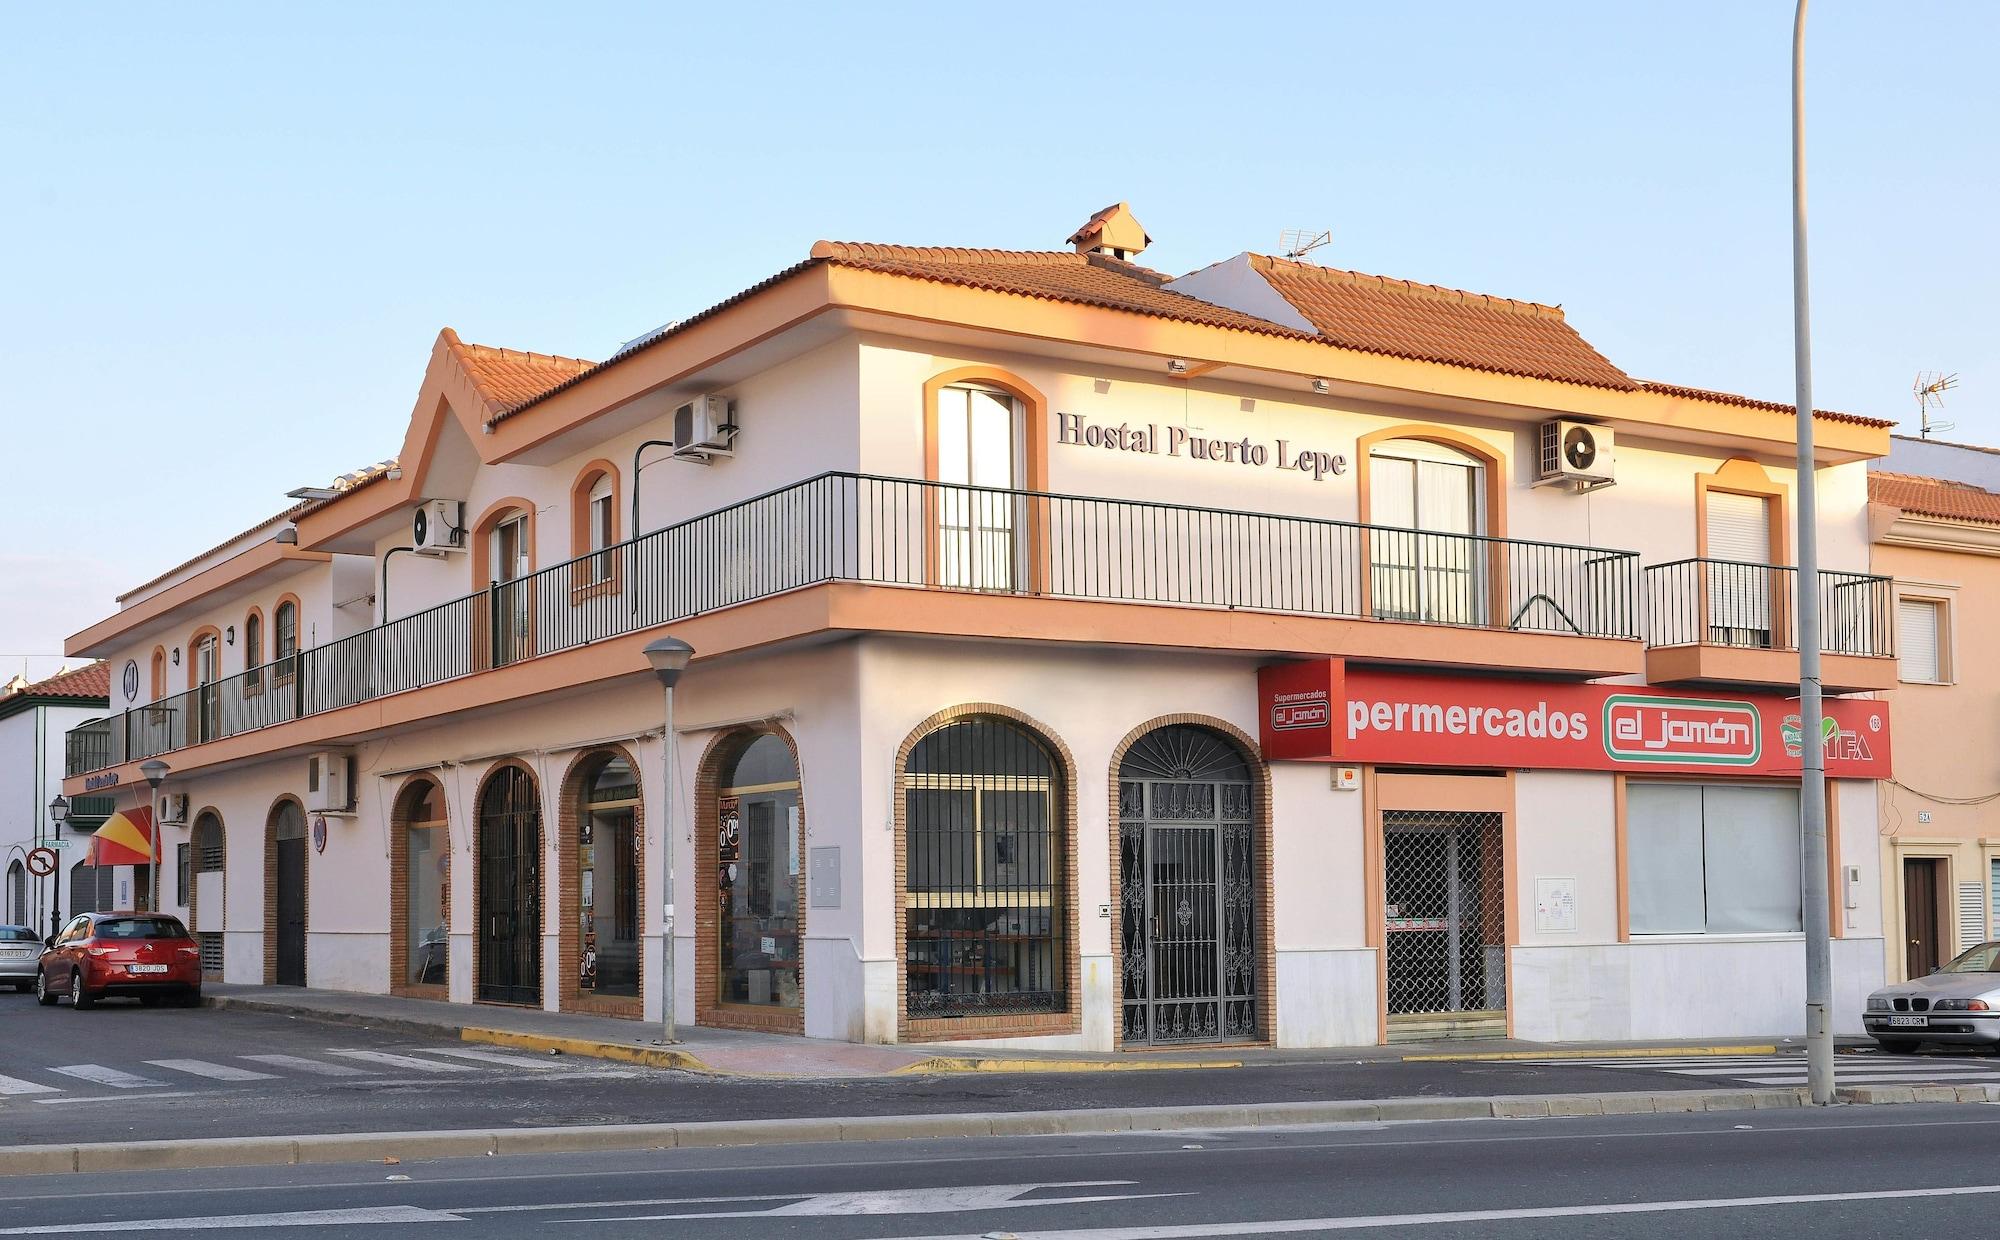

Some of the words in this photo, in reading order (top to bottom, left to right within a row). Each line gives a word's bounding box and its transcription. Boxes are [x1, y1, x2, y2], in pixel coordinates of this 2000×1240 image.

[1056, 412, 1159, 454] Hostal
[1167, 425, 1269, 466] Puerto
[1275, 439, 1347, 482] Lepe
[1274, 689, 1327, 703] Supermercados
[1347, 700, 1589, 740] permercados
[1615, 709, 1643, 741] el
[1644, 711, 1750, 749] jamón
